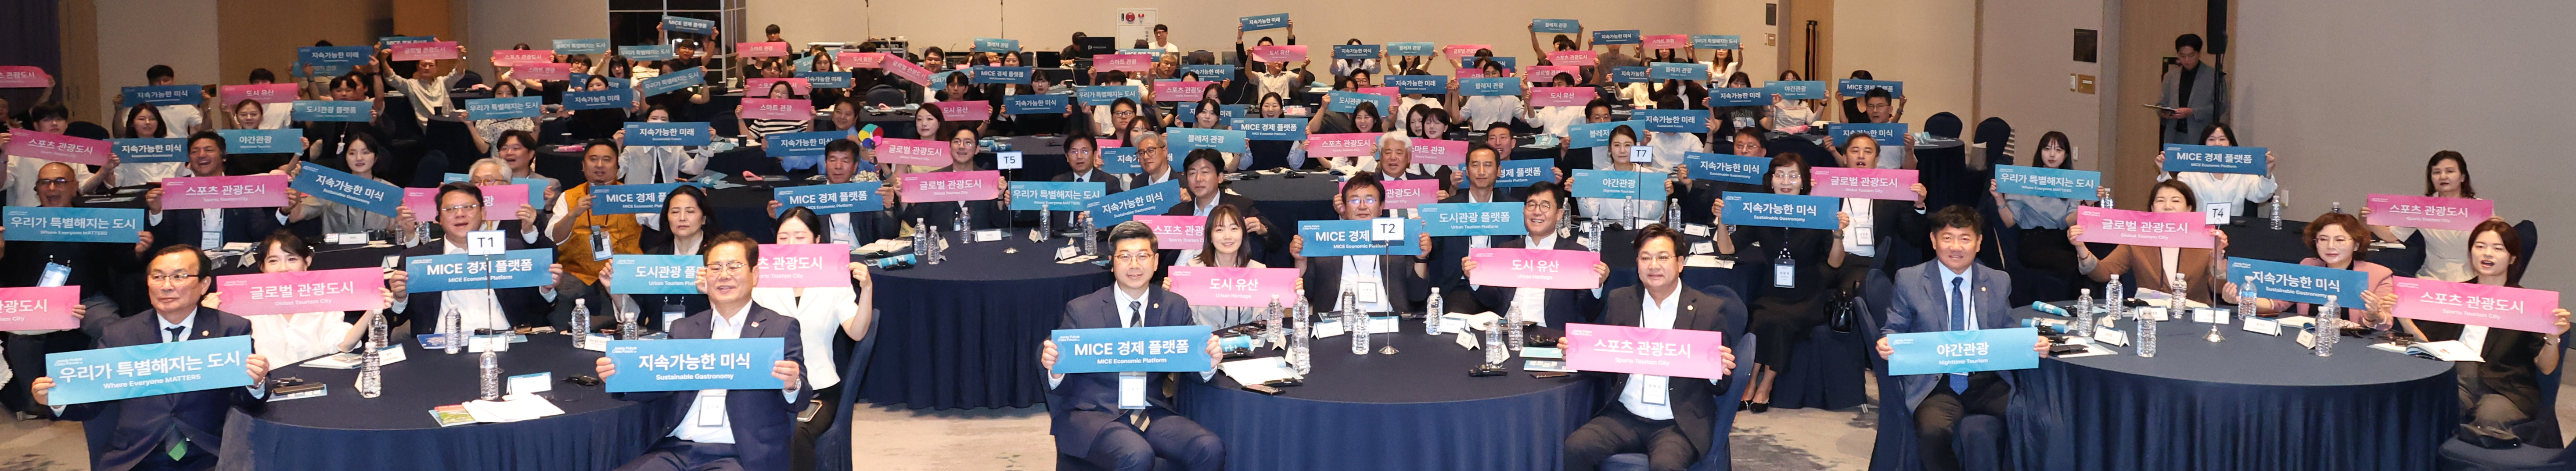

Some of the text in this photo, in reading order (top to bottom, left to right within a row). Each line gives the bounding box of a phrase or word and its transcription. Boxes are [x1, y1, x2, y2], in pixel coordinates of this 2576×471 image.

[1590, 129, 1609, 138] 블레저
[28, 139, 93, 155] 스포츠 관광도시
[122, 144, 163, 153] 지속가능한
[1343, 139, 1370, 147] 관광도시
[889, 145, 942, 157] 글로벌 관광도시
[1431, 146, 1445, 155] 관광
[2177, 152, 2252, 164] MICE 경제 플랫폼
[1700, 161, 1759, 174] 지속가능한 미식
[919, 179, 981, 190] 글로벌 관광도시
[1602, 178, 1636, 188] 야간관광
[1831, 176, 1897, 188] 글로벌 관광도시
[2000, 173, 2094, 189] 우리가 특별해지는 도시
[185, 184, 264, 195] 스포츠 관광도시
[316, 175, 385, 201] 지속가능한 미식
[1385, 188, 1420, 198] 관광도시
[606, 193, 655, 203] MICE 경제
[789, 191, 867, 204] MICE 경제 플랫폼
[1013, 190, 1100, 200] 우리가 특별해지는 도시
[1102, 191, 1163, 214] 지속가능한 미식
[1743, 202, 1817, 216] 지속가능한 미식
[2213, 208, 2223, 218] T4
[2389, 204, 2468, 218] 스포츠 관광도시
[11, 217, 135, 229] 우리가 특별해지는 도시
[1439, 212, 1510, 223] 도시관광 플랫폼
[1153, 225, 1182, 236] 스포츠
[1380, 224, 1395, 233] T2
[2102, 219, 2187, 234] 글로벌 관광도시
[1316, 230, 1370, 242] MICE 경제
[477, 237, 493, 248] T1
[427, 259, 533, 275] MICE 경제 플랫폼
[773, 256, 822, 270] 관광도시
[1511, 260, 1559, 272] 도시 유산
[635, 266, 682, 278] 도시관광
[1209, 278, 1259, 291] 도시 유산
[2252, 271, 2340, 293] 지속가능한 미식
[250, 281, 353, 300] 글로벌 관광도시
[2296, 291, 2327, 299] Gastronomy
[2420, 292, 2524, 314] 스포츠 관광도시
[1075, 339, 1189, 356] MICE 경제 플랫폼
[1594, 339, 1691, 359] 스포츠 관광도시
[1937, 342, 1989, 357] 야간관광
[59, 350, 240, 383] 우리가 특별해지는 도시
[638, 352, 750, 371] 지속가능한 미식
[165, 374, 201, 383] MATTERS
